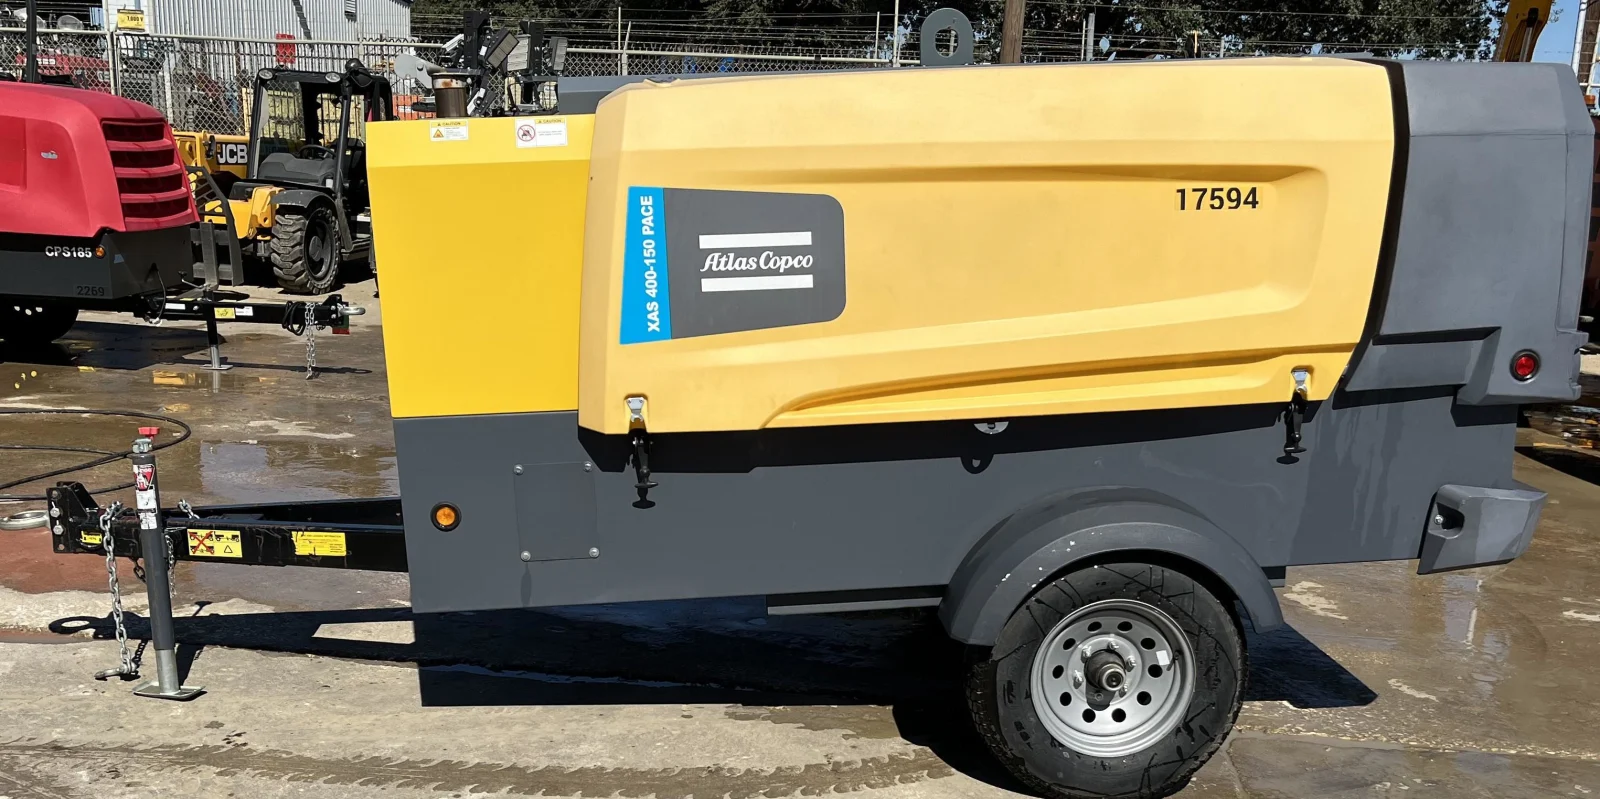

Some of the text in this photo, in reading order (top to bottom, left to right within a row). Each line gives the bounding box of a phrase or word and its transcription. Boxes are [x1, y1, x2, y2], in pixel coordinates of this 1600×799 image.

[217, 144, 248, 164] JCB
[1176, 186, 1259, 210] 17594
[45, 246, 92, 258] CPS185
[700, 250, 814, 273] Atlas Copco
[640, 196, 660, 332] XAS 400-150 PACE
[76, 286, 105, 297] 2269
